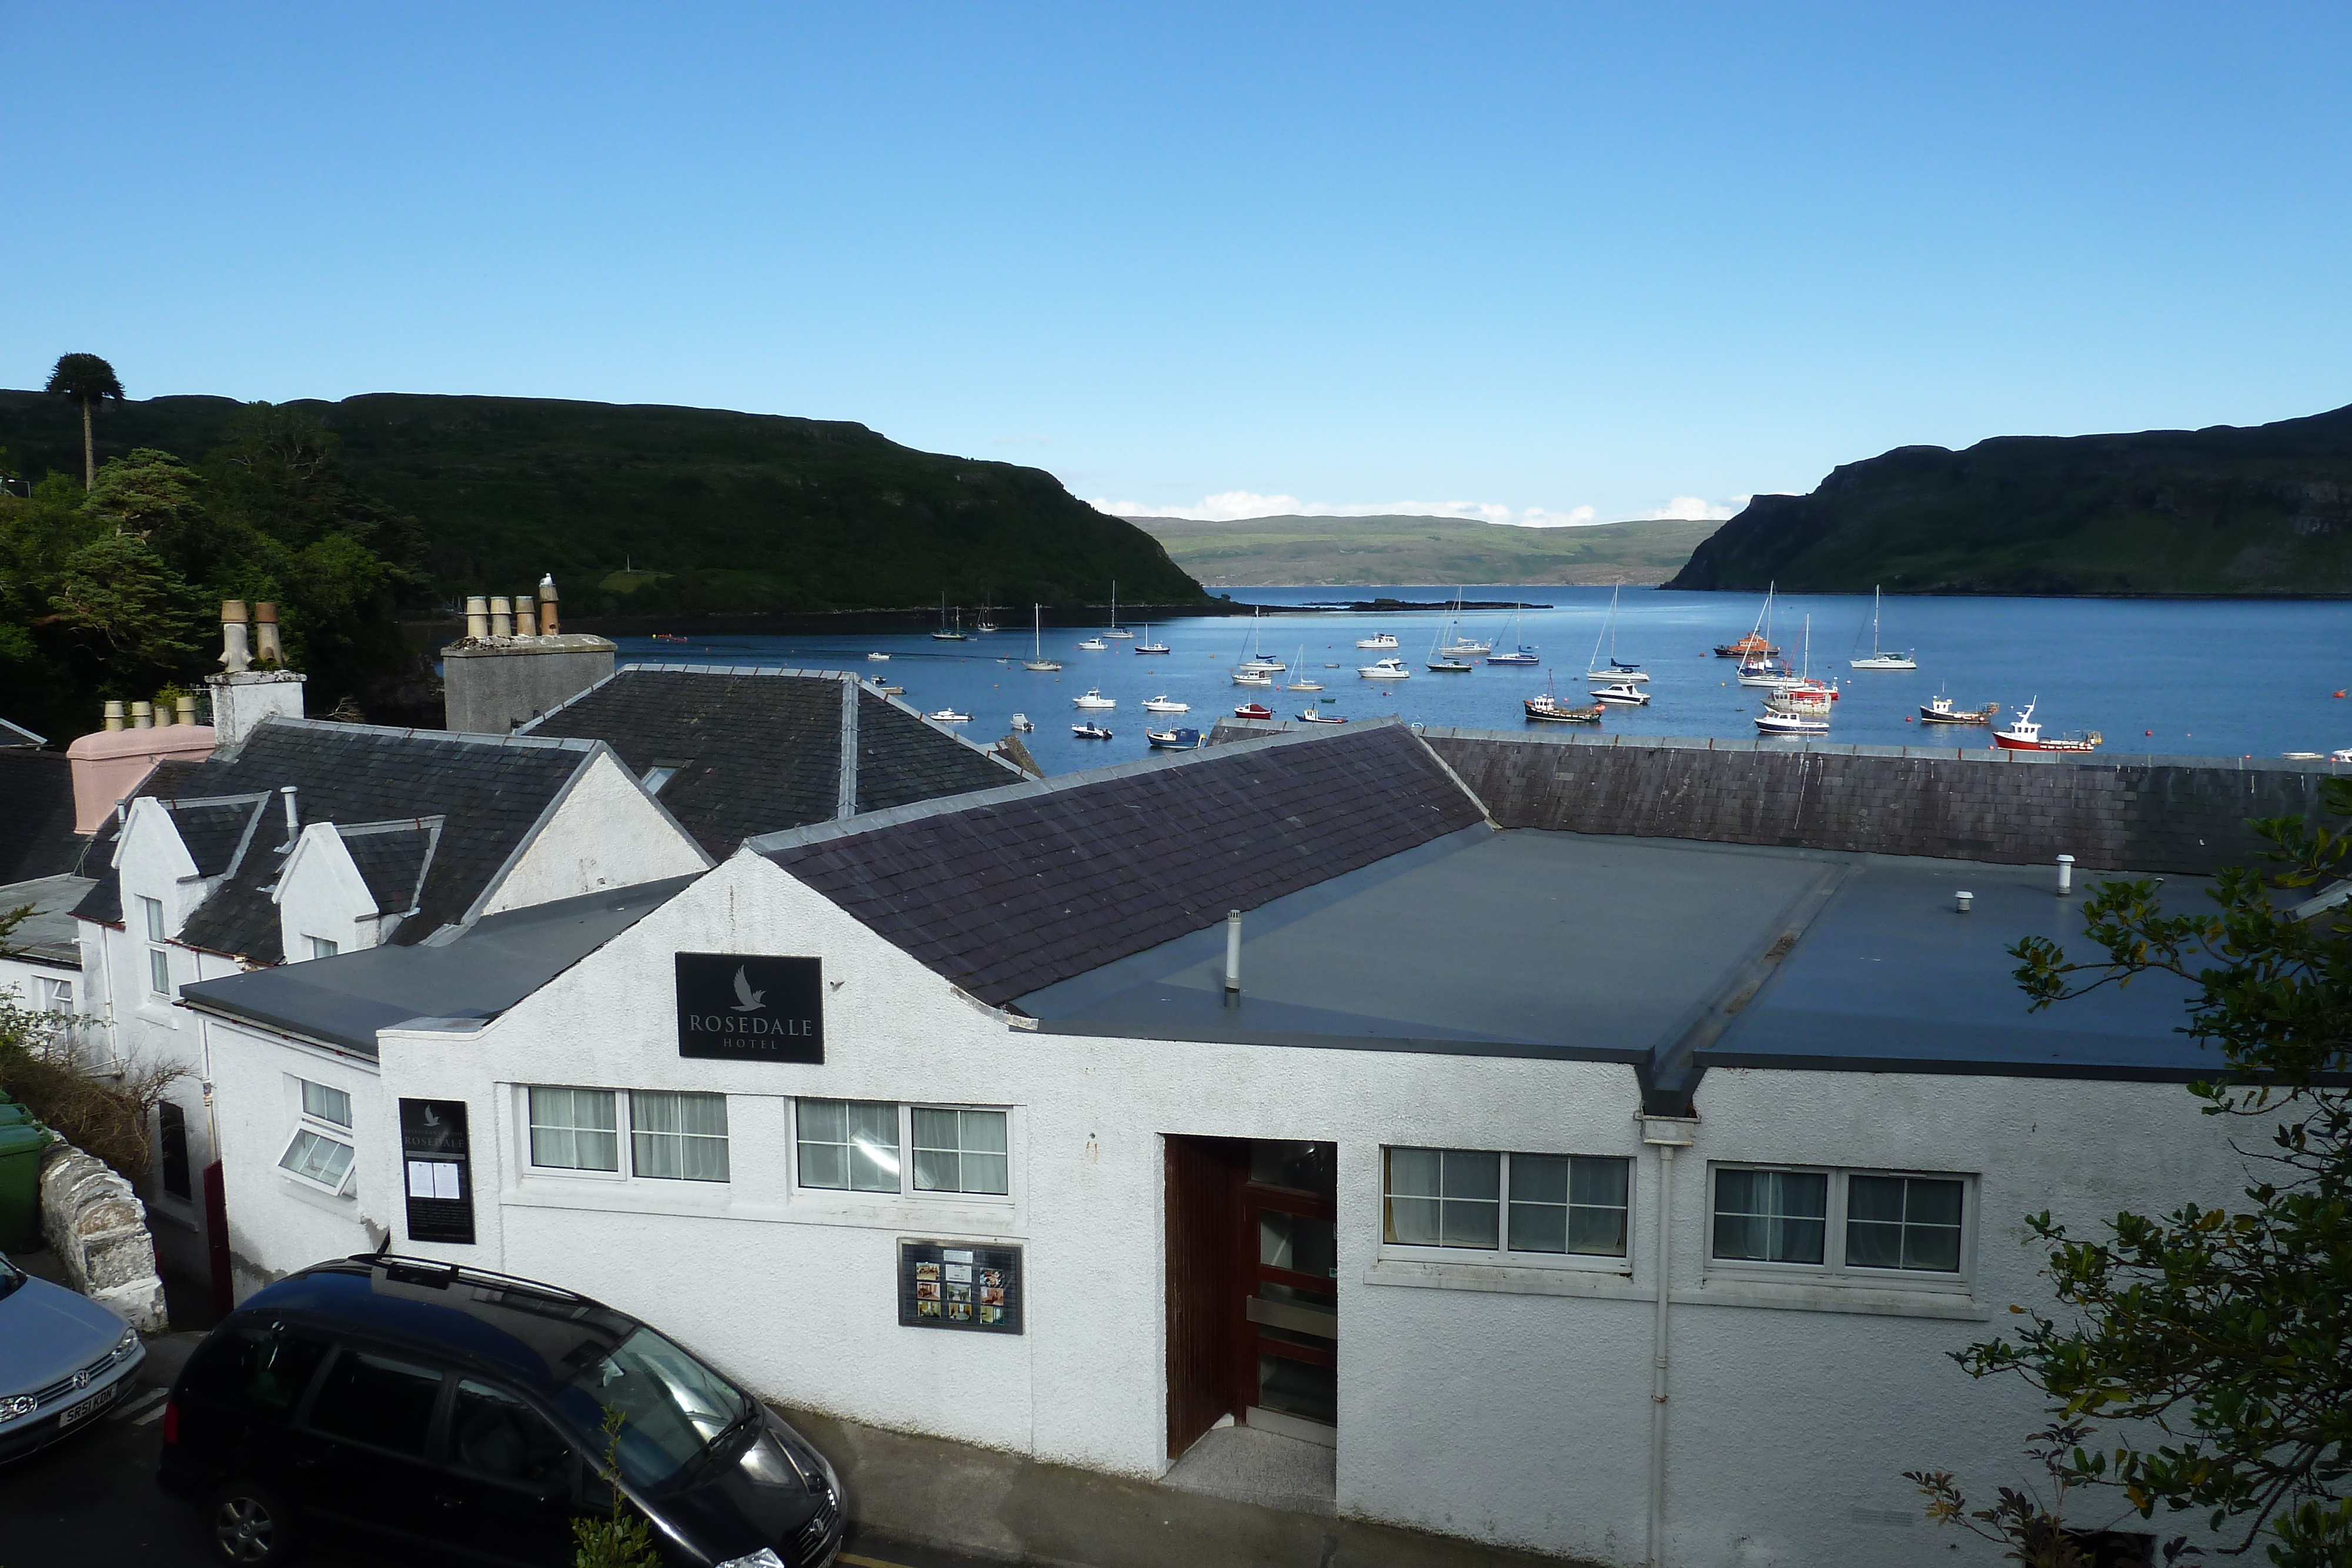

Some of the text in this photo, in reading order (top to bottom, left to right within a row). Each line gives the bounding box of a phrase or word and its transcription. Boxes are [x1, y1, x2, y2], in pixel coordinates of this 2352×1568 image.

[689, 1014, 813, 1037] ROSEDALE
[723, 1038, 777, 1049] HOTEL
[405, 1136, 465, 1148] ROSEDALE
[67, 1400, 92, 1422] SR51
